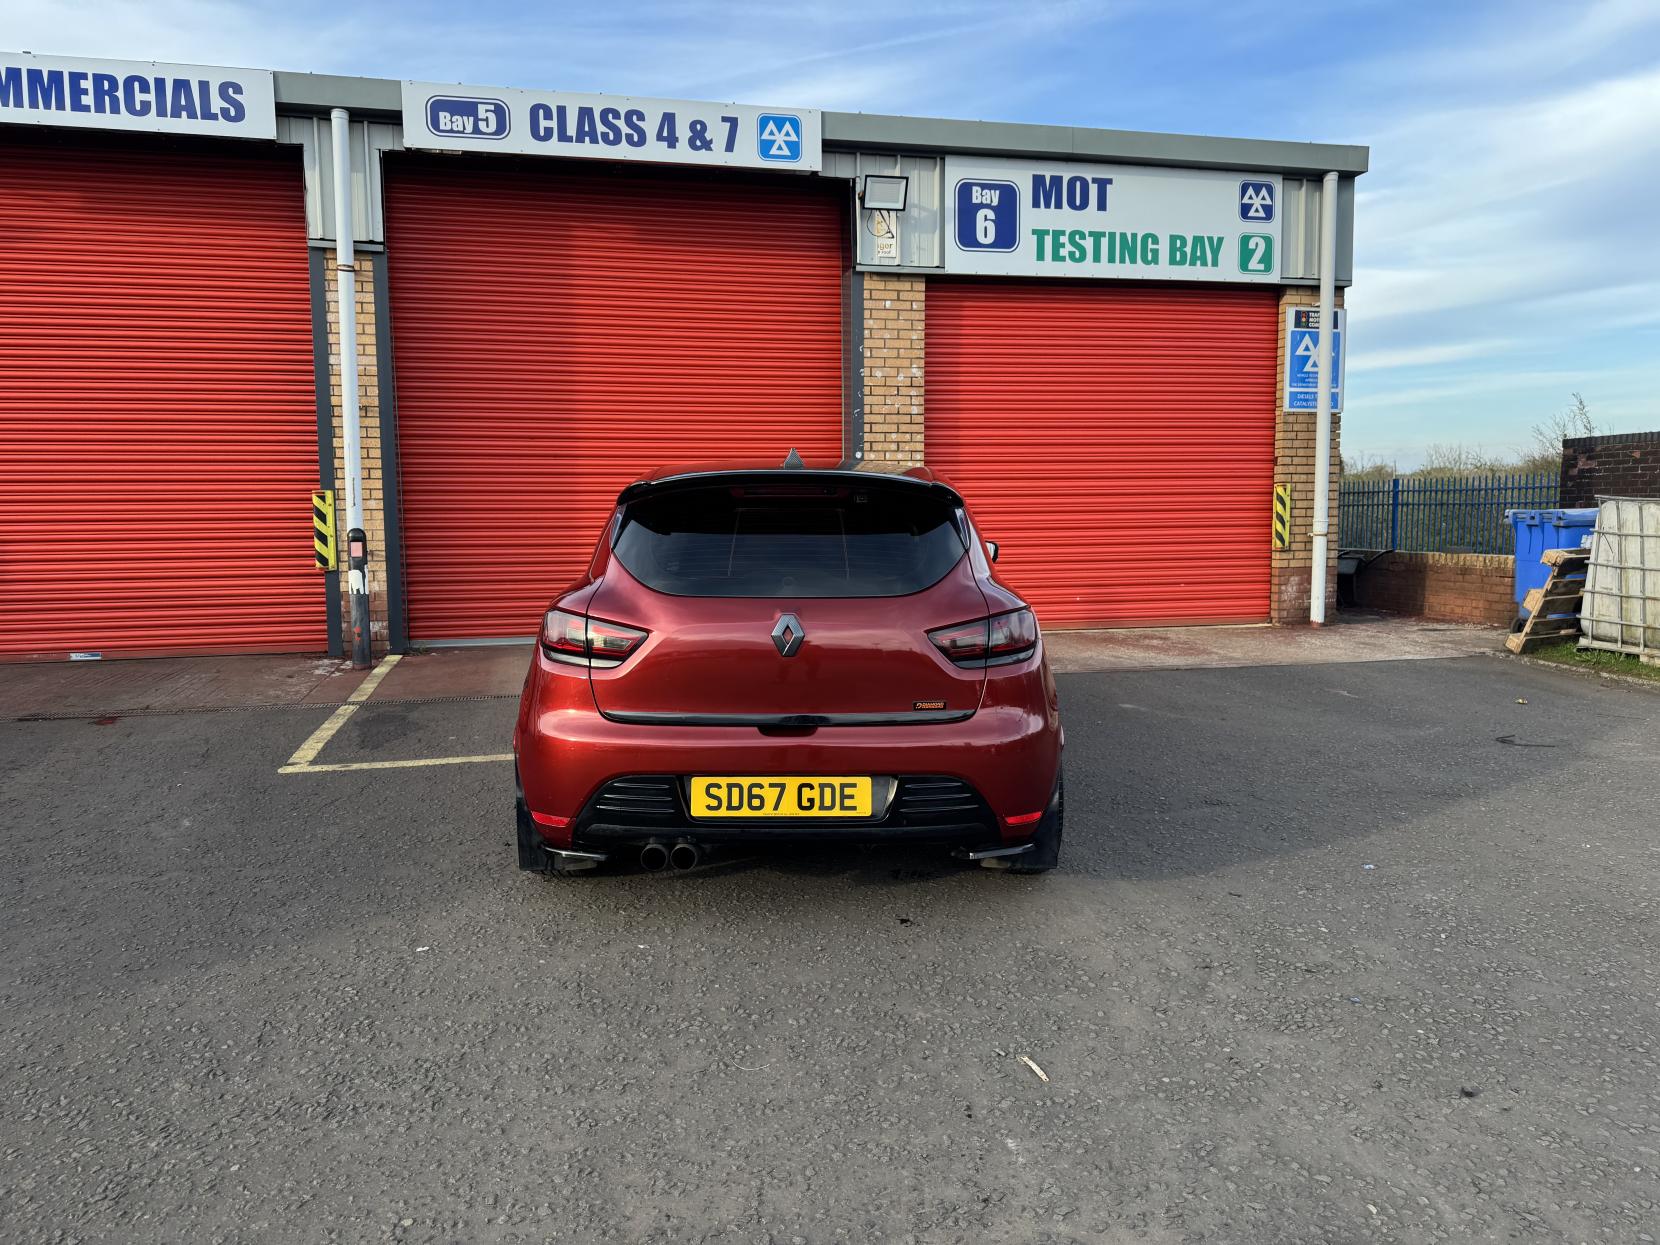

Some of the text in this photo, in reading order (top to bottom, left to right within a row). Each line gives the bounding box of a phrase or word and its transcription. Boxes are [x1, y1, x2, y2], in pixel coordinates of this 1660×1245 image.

[438, 103, 498, 135] Bay 5
[529, 102, 739, 153] CLASS 4 & 7
[971, 186, 1000, 206] Bay
[1031, 174, 1113, 212] MOT
[976, 208, 996, 246] 6
[1031, 228, 1225, 268] TESTING BAY
[1247, 236, 1266, 271] 2
[704, 782, 858, 812] SD67 GDE
